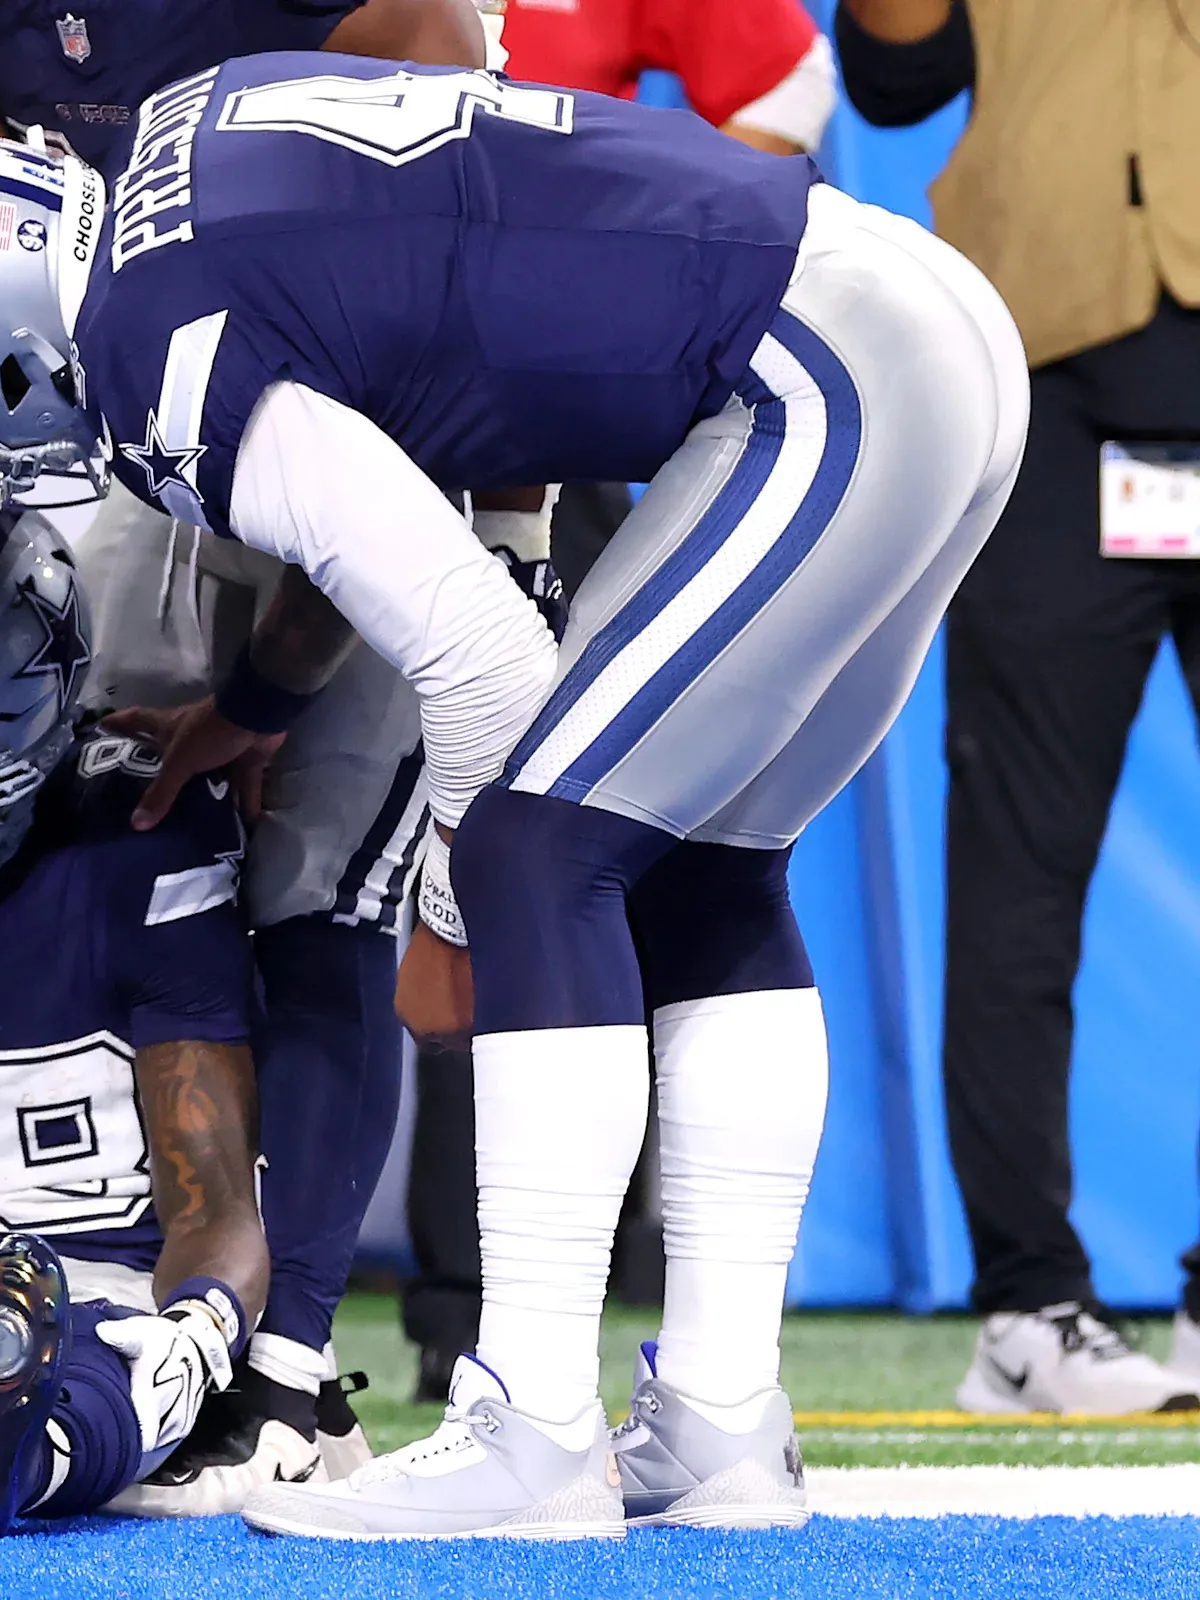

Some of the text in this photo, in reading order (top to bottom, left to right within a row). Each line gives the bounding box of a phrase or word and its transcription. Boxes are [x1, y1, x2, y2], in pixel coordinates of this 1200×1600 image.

[216, 70, 574, 168] 4
[111, 65, 220, 273] PRESCOTT
[19, 221, 46, 250] 94
[73, 181, 97, 262] CHOOSE
[422, 895, 457, 925] GOD
